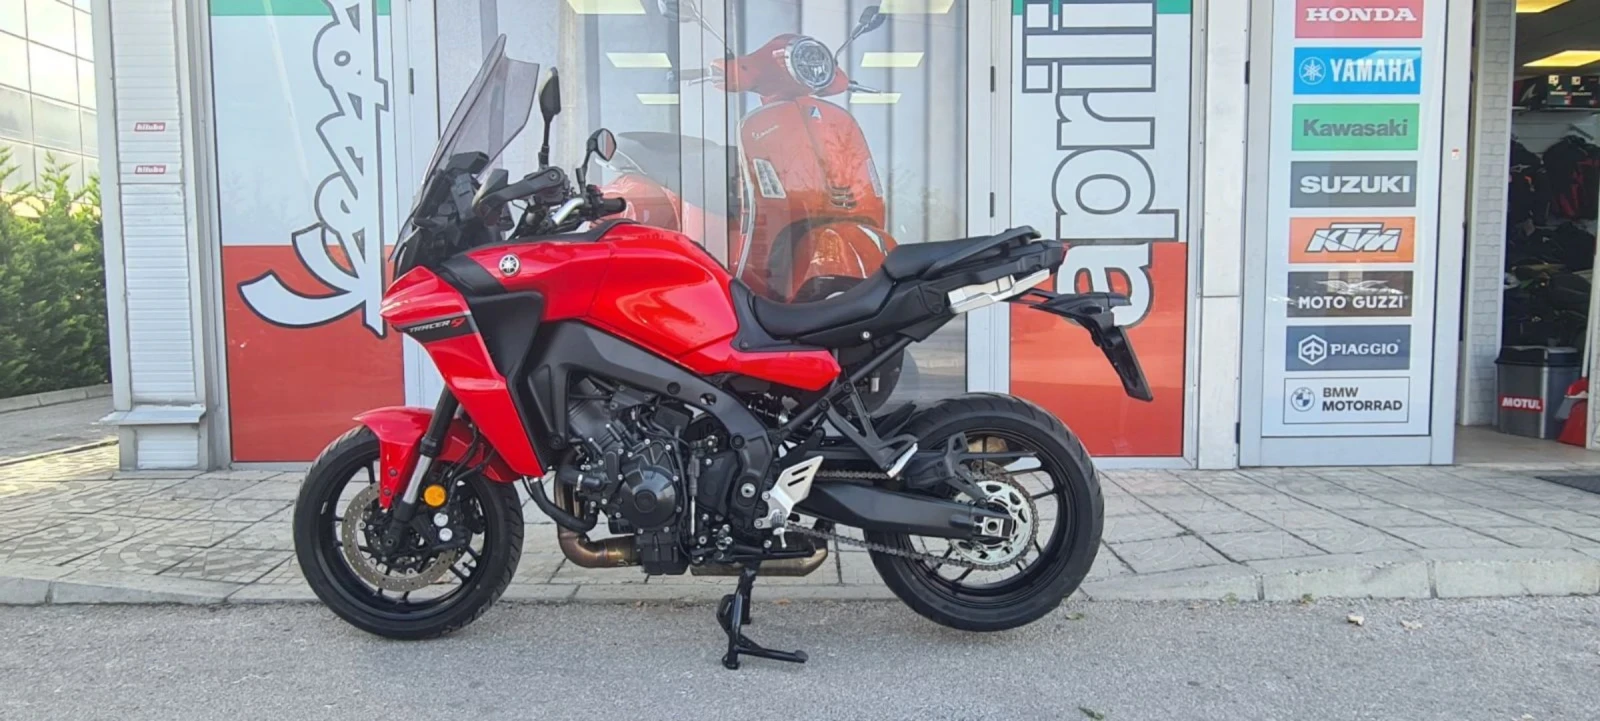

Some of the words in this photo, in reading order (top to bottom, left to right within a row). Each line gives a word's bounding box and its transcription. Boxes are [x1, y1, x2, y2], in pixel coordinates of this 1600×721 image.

[1305, 7, 1417, 22] HONDA
[1329, 58, 1416, 82] YAMAHA
[1303, 118, 1408, 137] Kawasaki
[237, 0, 389, 339] Vesp
[1300, 175, 1411, 193] SUZUKI
[1304, 222, 1402, 252] KTM
[1298, 296, 1347, 309] MOTO
[1352, 295, 1403, 309] GUZZI
[409, 320, 451, 333] TRACER
[451, 317, 466, 328] 9
[1330, 343, 1399, 355] PIAGGIO
[1322, 387, 1359, 398] BMW
[1321, 400, 1403, 412] MOTORRAD
[1502, 397, 1541, 410] MOTUL
